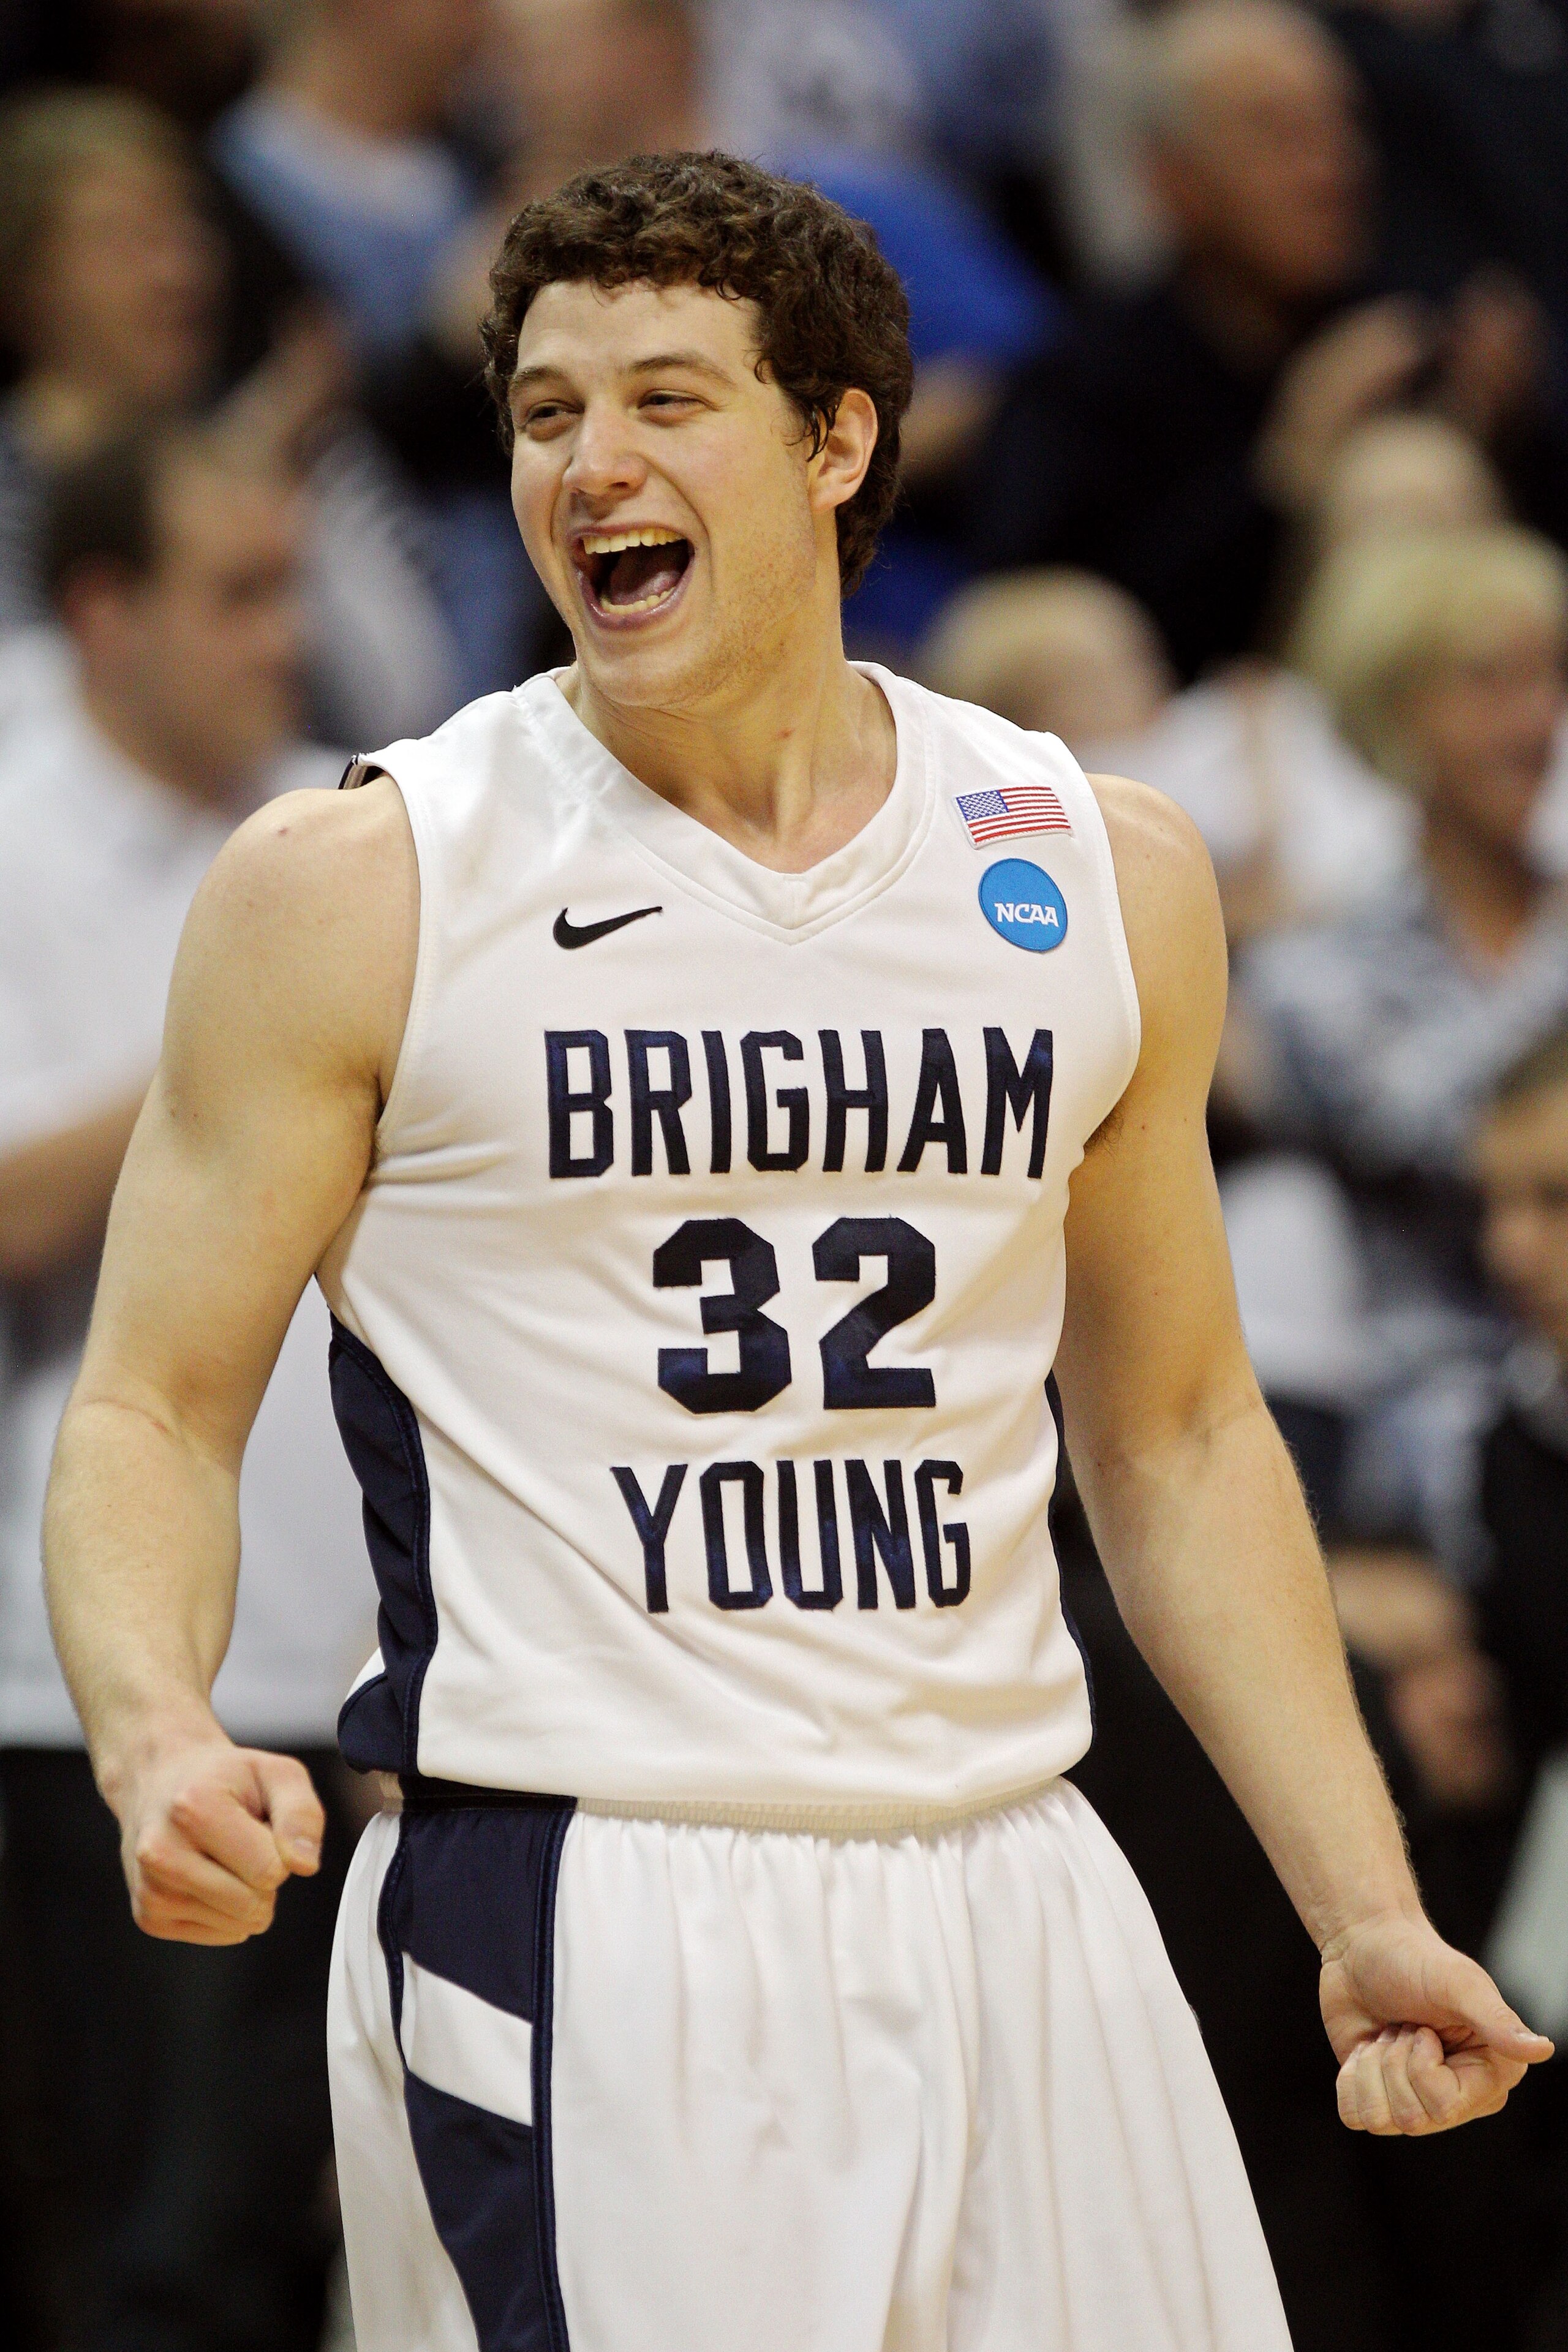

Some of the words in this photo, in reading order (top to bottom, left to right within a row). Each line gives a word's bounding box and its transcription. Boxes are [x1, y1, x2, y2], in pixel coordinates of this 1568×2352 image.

[994, 902, 1059, 927] NCAA
[544, 1027, 1054, 1180] BRIGHAM
[652, 1216, 937, 1415] 32
[609, 1458, 971, 1615] YOUNG
